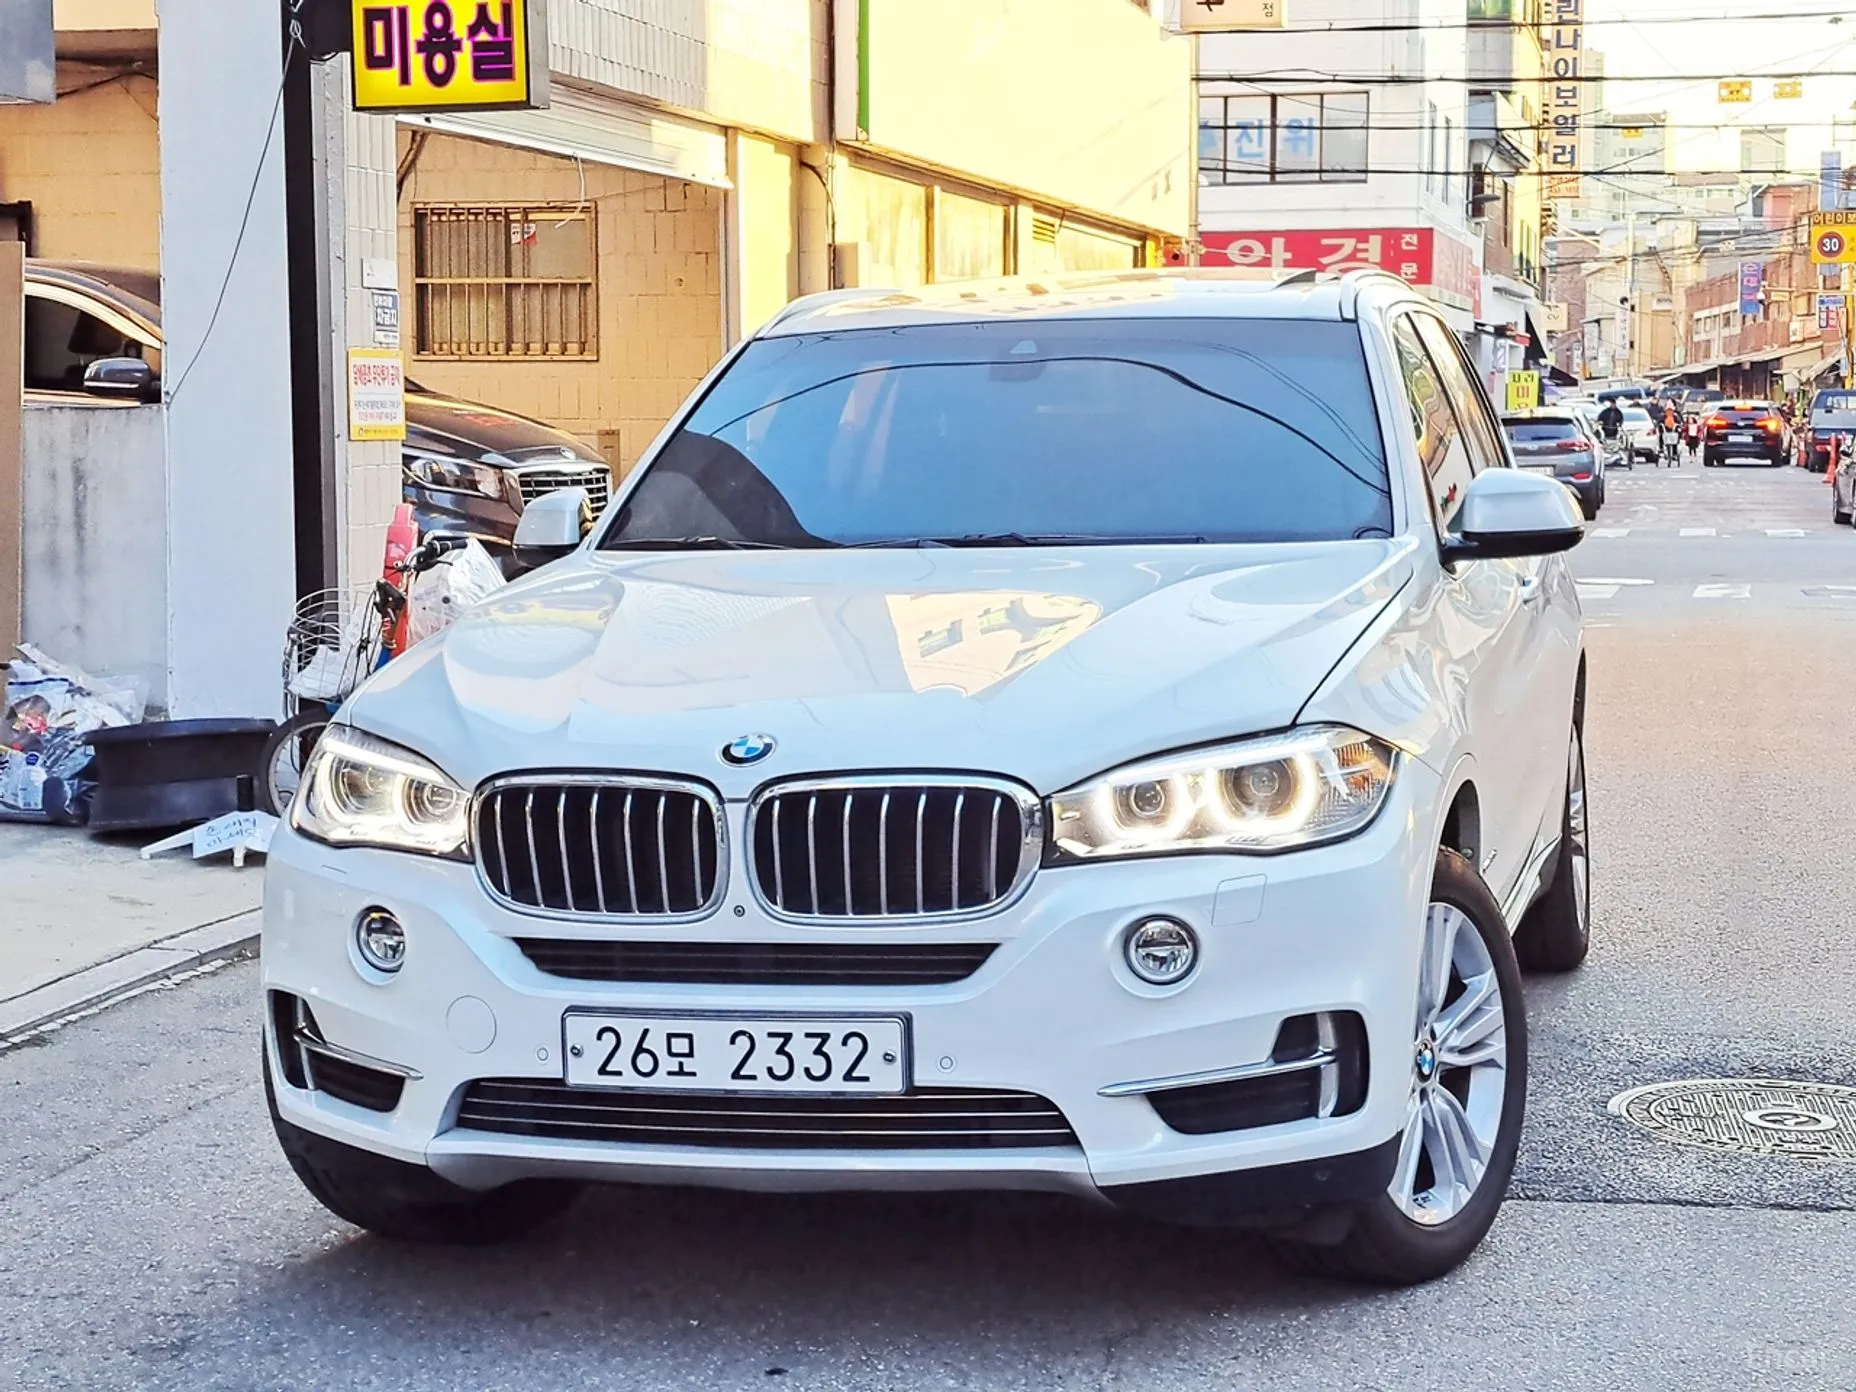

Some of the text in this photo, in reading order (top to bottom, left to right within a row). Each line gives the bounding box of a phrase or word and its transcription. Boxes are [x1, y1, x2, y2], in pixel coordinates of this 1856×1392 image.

[362, 0, 516, 88] 미용실
[1226, 234, 1382, 276] 안경
[1822, 238, 1839, 252] 30
[596, 1026, 871, 1083] 26모 2332
